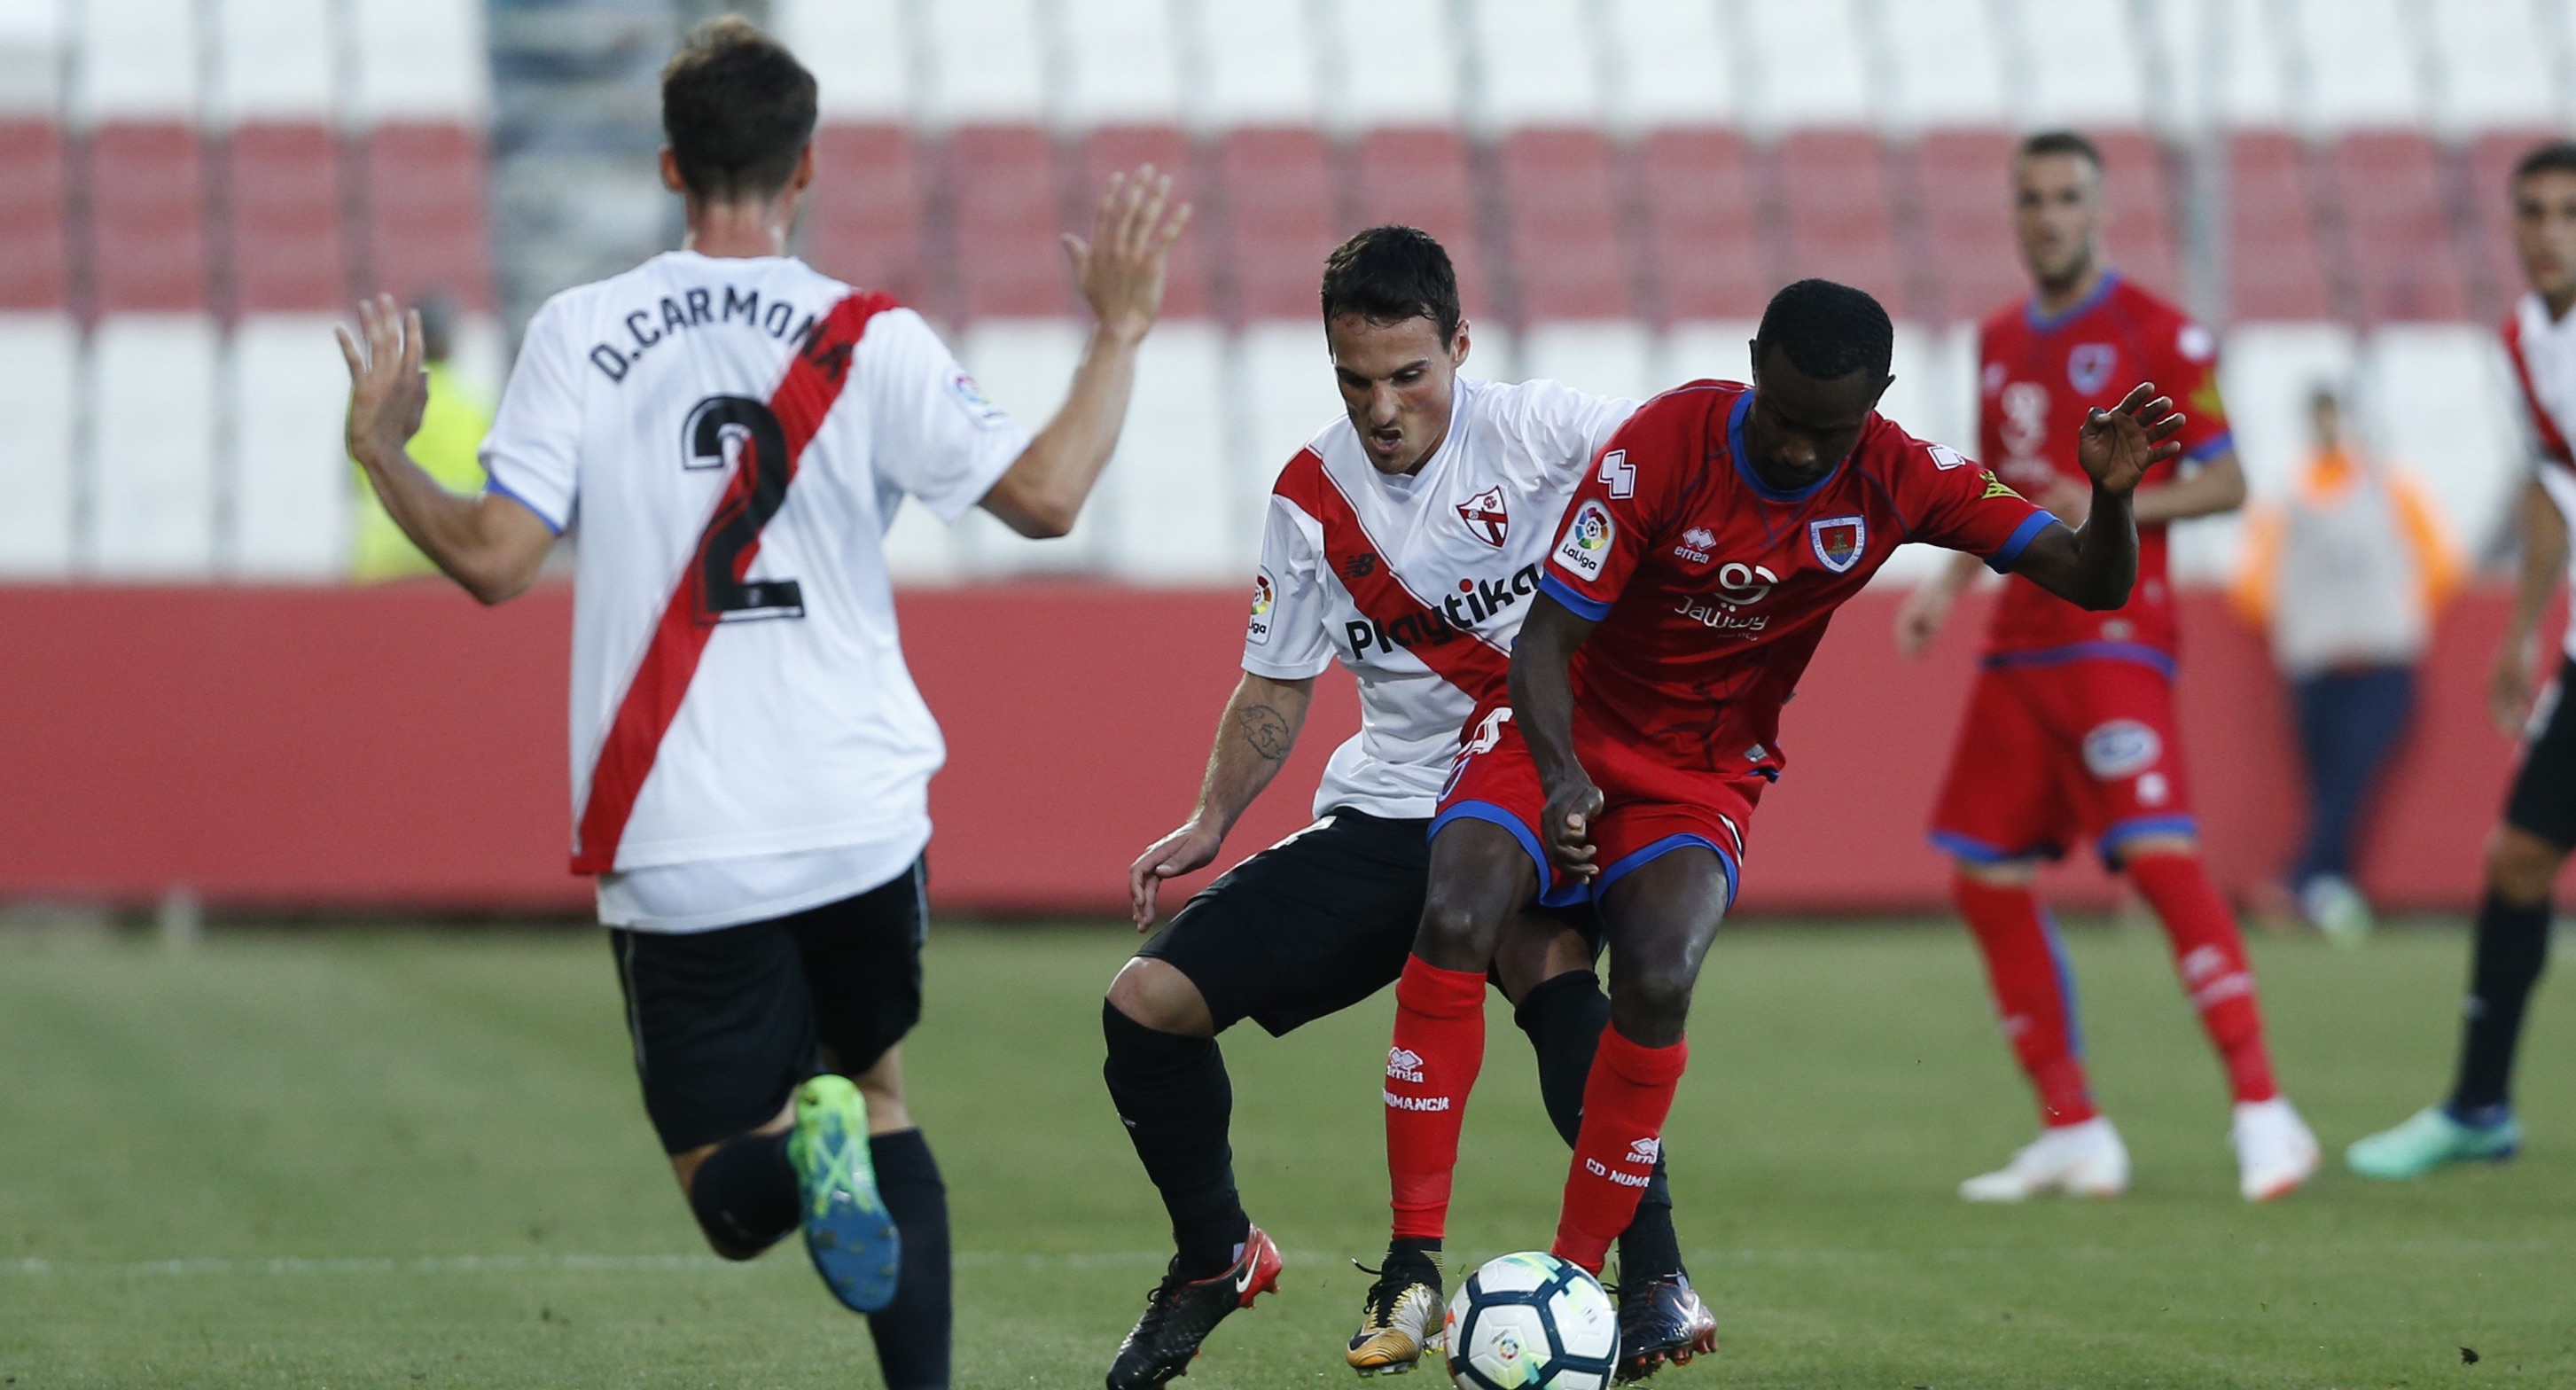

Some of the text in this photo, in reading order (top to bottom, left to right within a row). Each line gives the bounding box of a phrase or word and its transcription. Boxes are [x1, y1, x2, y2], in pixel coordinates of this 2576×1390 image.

[589, 284, 854, 383] D.CARMONA
[681, 395, 805, 627] 2
[1562, 543, 1597, 571] LaLiga
[1674, 545, 1711, 565] errea
[1346, 563, 1541, 660] Playtika
[1585, 1157, 1607, 1177] CD
